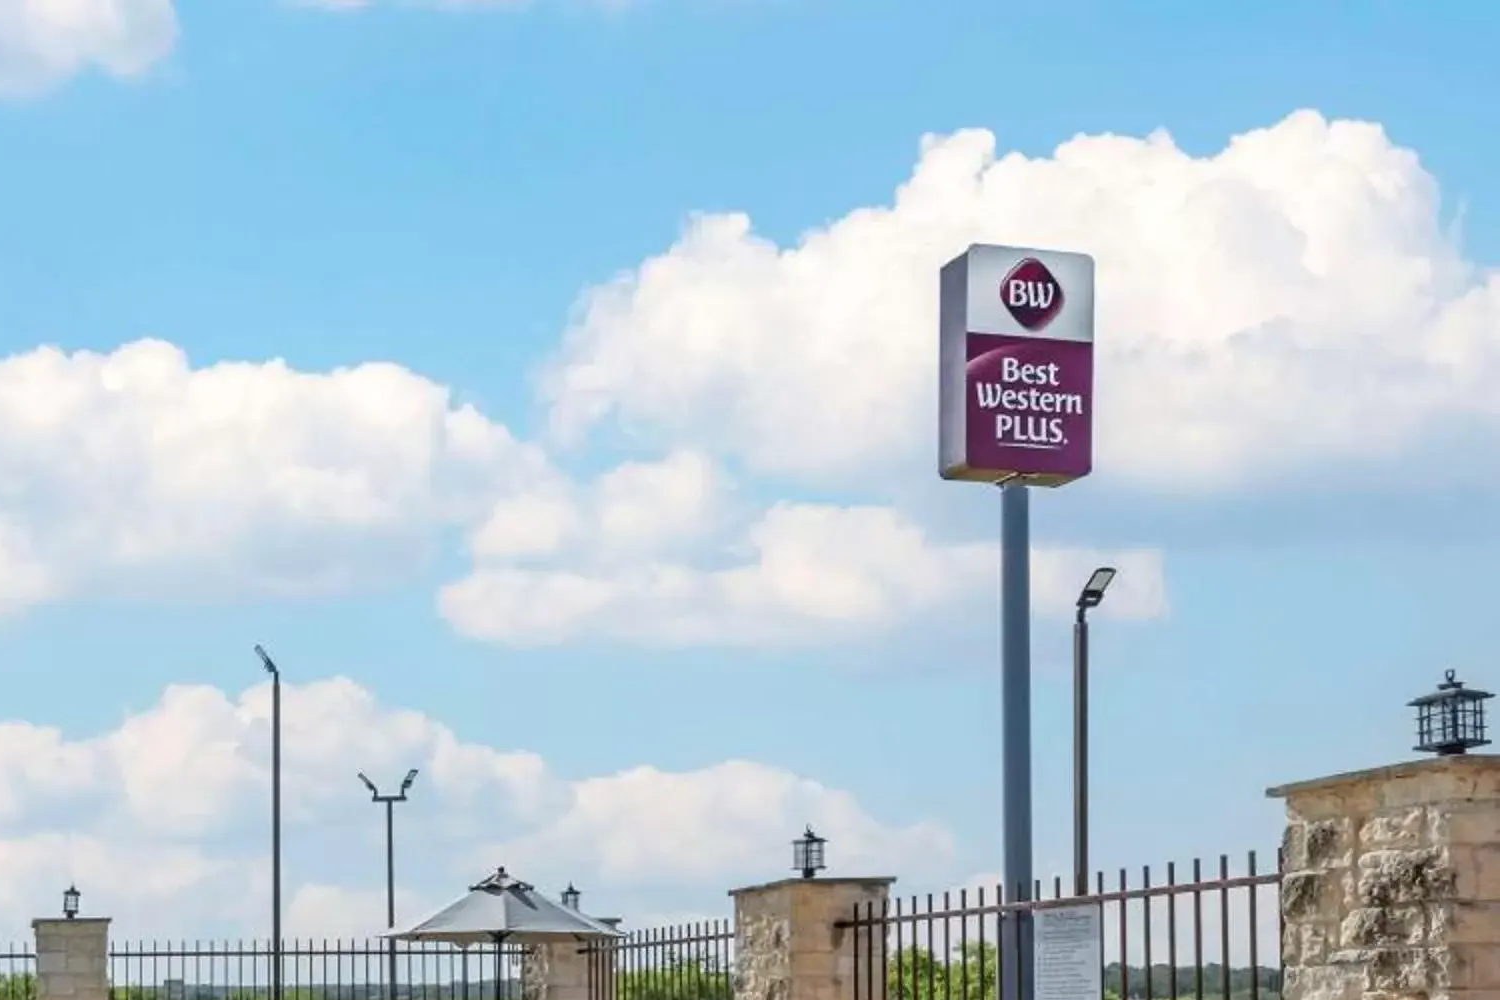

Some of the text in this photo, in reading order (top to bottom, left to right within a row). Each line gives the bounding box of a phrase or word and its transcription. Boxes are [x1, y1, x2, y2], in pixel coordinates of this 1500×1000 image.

[1008, 279, 1055, 309] BW
[1002, 357, 1060, 386] Best
[976, 382, 1083, 415] Western
